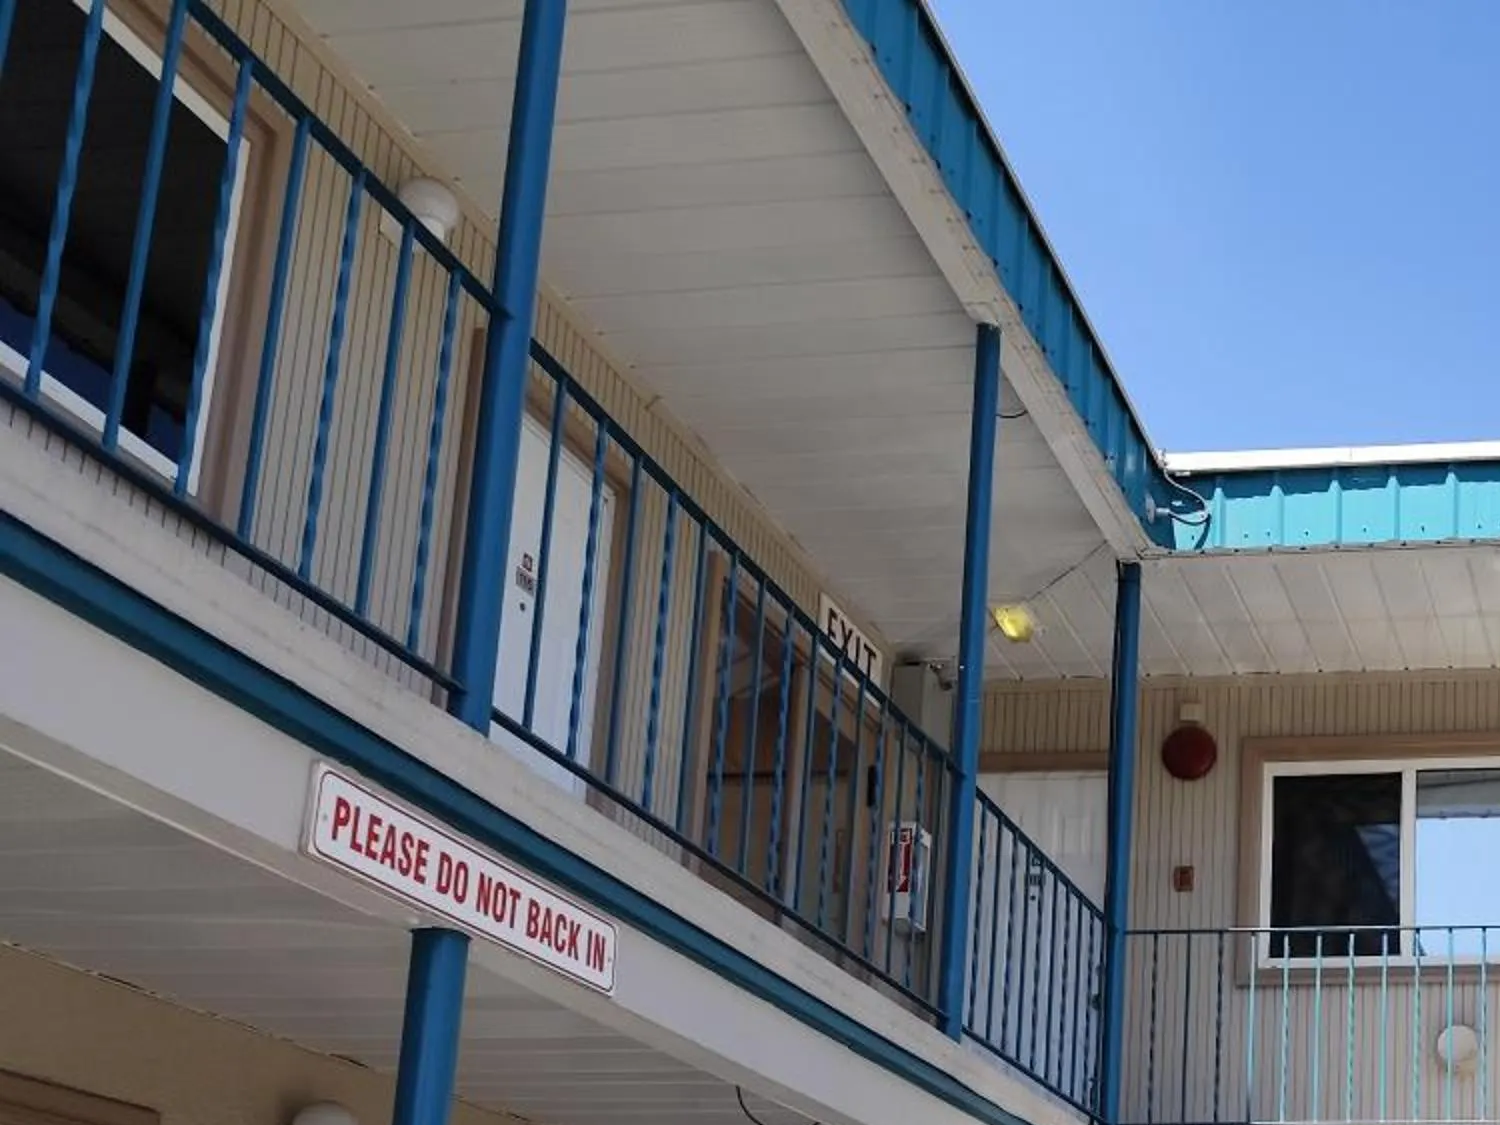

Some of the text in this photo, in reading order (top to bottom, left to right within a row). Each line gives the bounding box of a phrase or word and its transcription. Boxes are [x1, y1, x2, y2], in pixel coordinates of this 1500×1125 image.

[827, 607, 877, 681] EXIT
[331, 796, 606, 972] PLEASE DO NOT BACK IN
